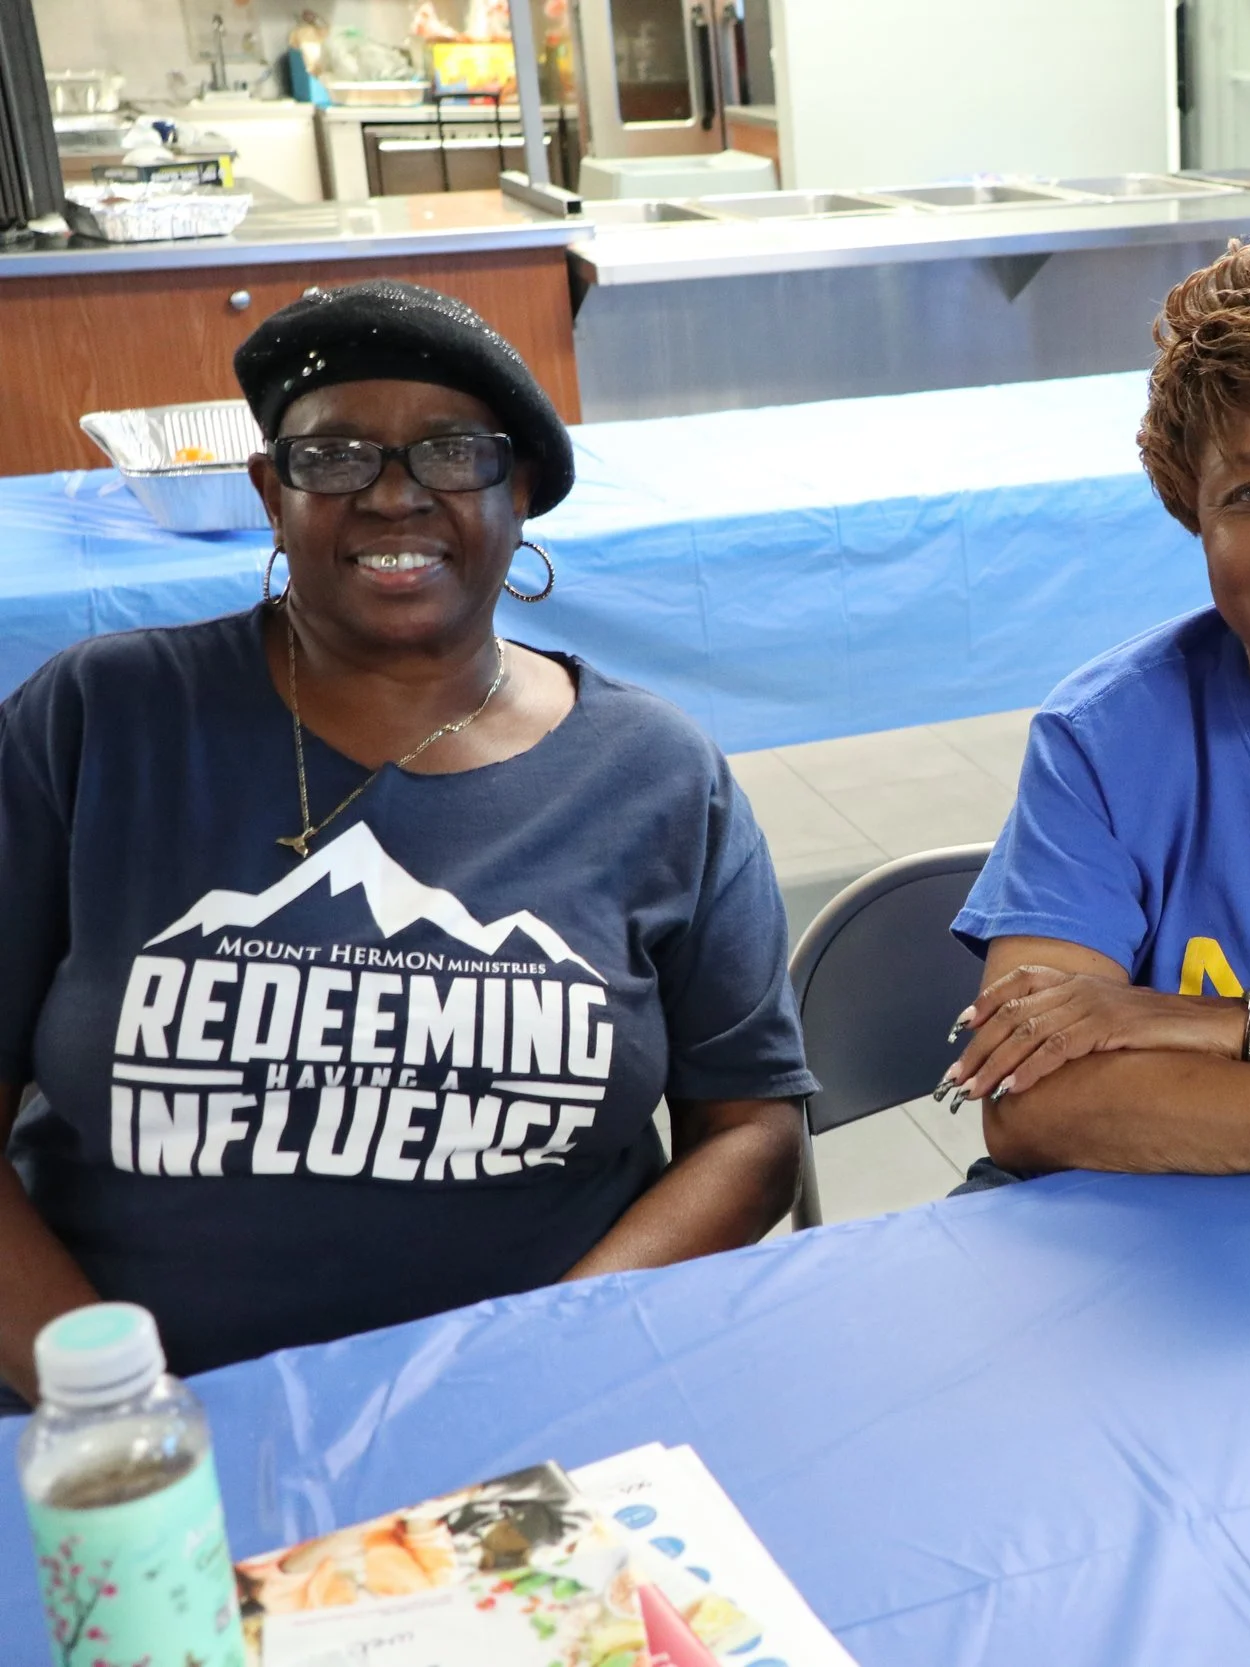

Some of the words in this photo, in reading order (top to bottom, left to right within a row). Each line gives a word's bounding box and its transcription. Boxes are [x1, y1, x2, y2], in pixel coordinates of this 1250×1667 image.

[329, 943, 444, 971] HERMON
[447, 958, 546, 975] MINISTRIES
[114, 955, 614, 1080] REDEEMING
[265, 1063, 418, 1090] HAVING
[439, 1069, 459, 1091] A
[110, 1085, 597, 1182] INFLUENCE
